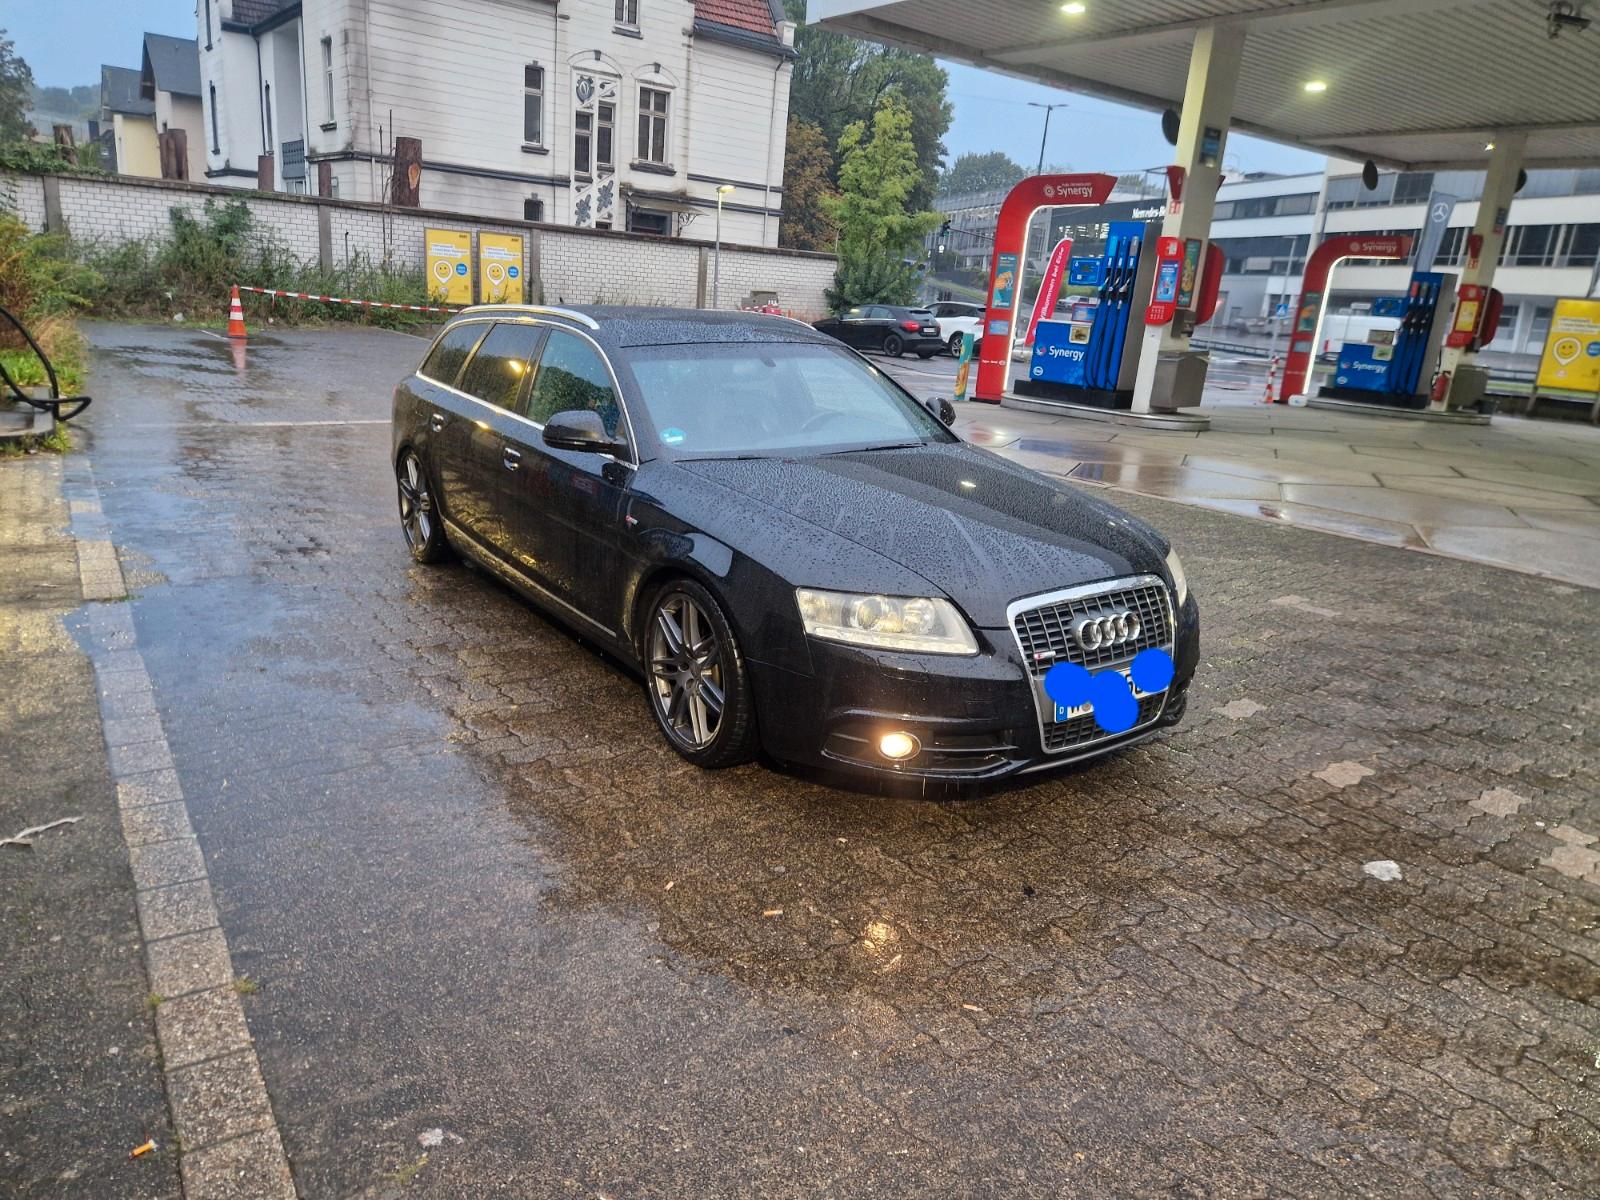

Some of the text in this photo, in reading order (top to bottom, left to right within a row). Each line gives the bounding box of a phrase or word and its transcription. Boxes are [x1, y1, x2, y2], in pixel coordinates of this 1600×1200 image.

[1057, 186, 1093, 198] Synergy
[1132, 206, 1166, 218] Mercedes-B
[1363, 242, 1397, 253] Synergy
[1049, 345, 1084, 361] Synergy
[1353, 361, 1387, 373] Synergy
